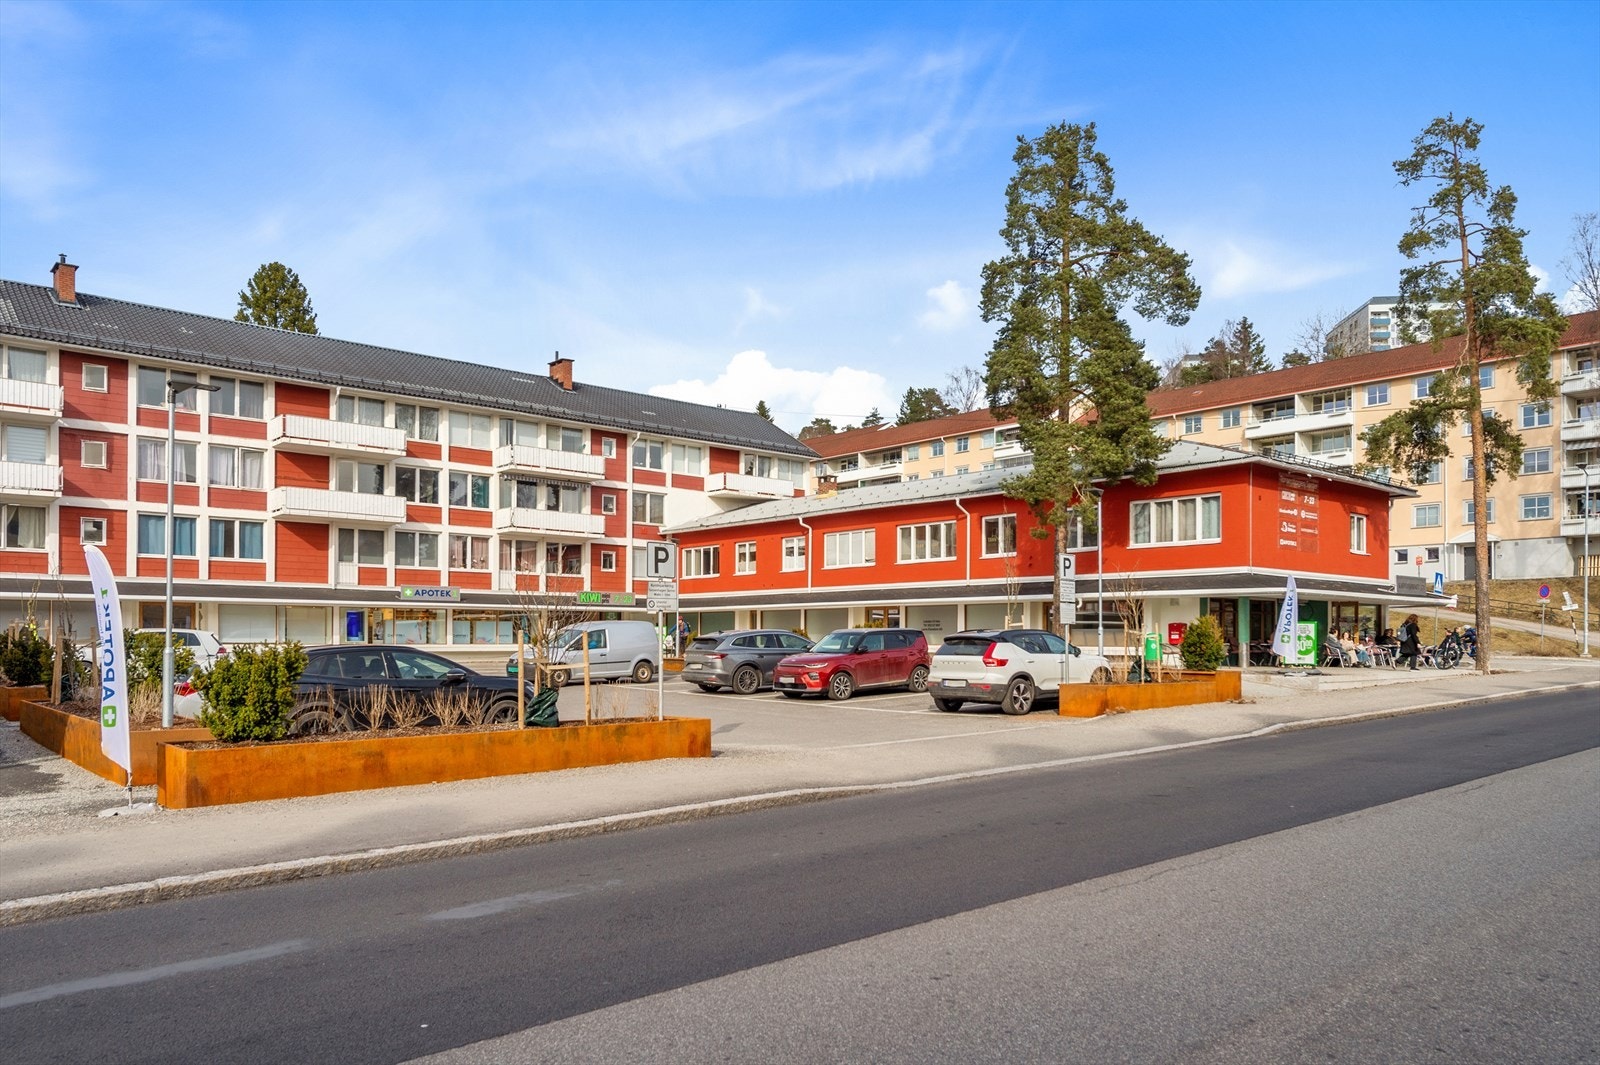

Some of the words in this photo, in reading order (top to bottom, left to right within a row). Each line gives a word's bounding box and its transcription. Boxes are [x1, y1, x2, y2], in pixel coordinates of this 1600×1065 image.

[654, 546, 670, 574] P
[1063, 557, 1072, 577] P
[414, 589, 452, 598] APOTEK
[580, 591, 602, 604] KIWI
